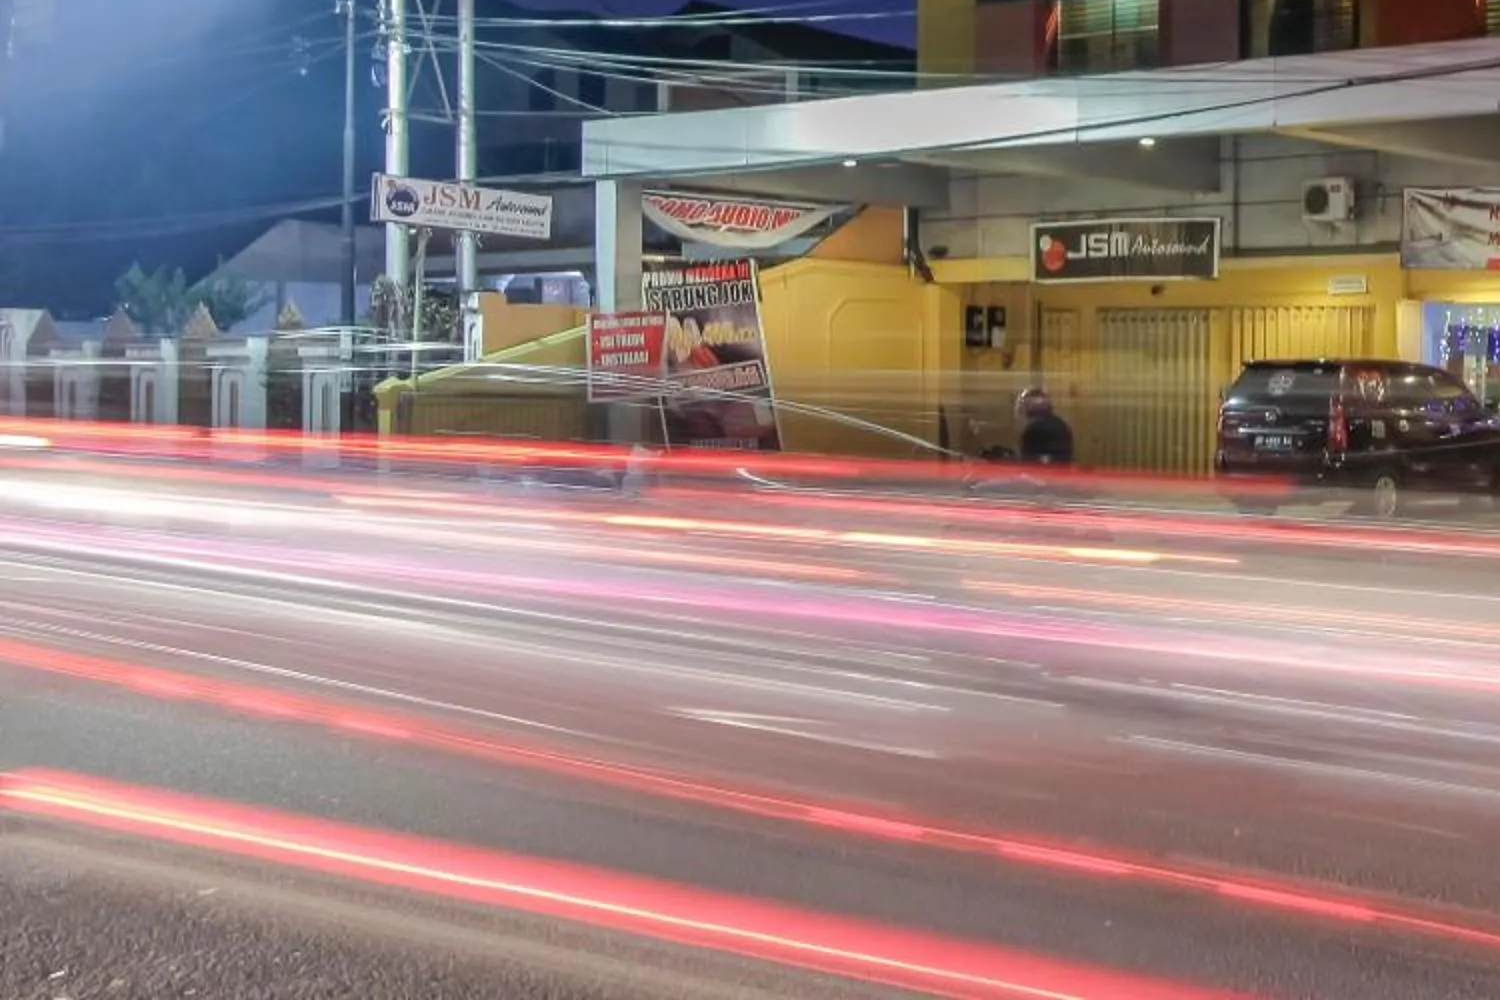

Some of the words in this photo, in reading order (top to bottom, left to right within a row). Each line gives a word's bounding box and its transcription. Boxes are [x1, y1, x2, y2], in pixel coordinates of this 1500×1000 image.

[423, 185, 481, 210] JSM
[1067, 231, 1129, 259] JSM
[1131, 233, 1210, 257] Autosound
[642, 269, 684, 288] PROMO
[648, 284, 718, 311] SARUNG
